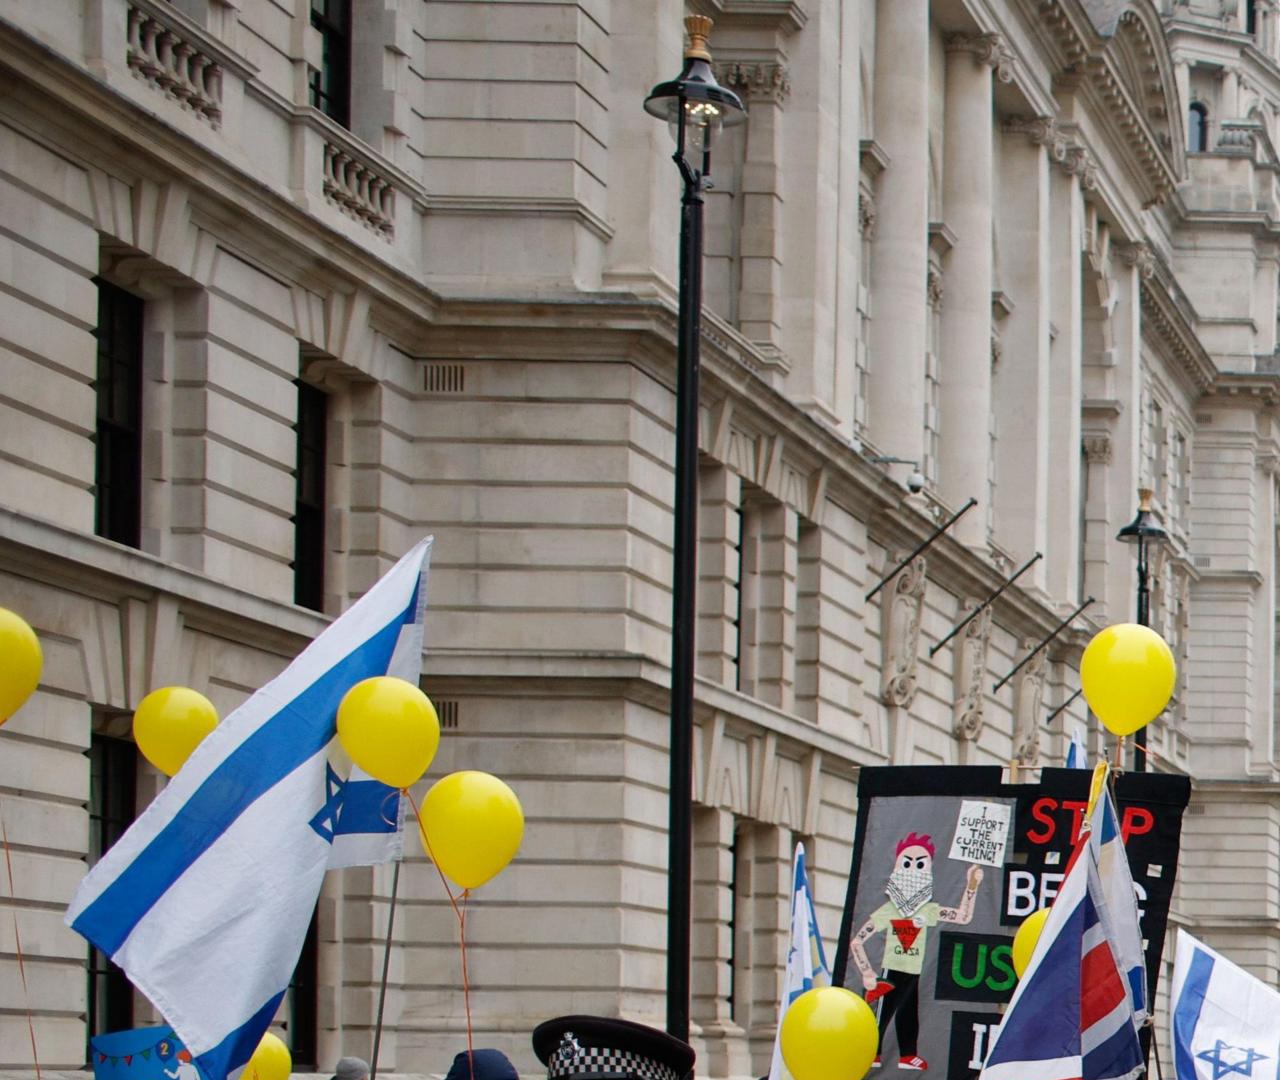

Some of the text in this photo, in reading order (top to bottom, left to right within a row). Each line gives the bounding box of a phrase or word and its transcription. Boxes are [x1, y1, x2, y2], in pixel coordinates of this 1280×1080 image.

[960, 817, 1004, 832] SUPPORT
[1026, 797, 1155, 846] STP
[970, 828, 993, 841] THE
[956, 837, 1004, 852] CURRENT
[960, 846, 996, 864] THING!
